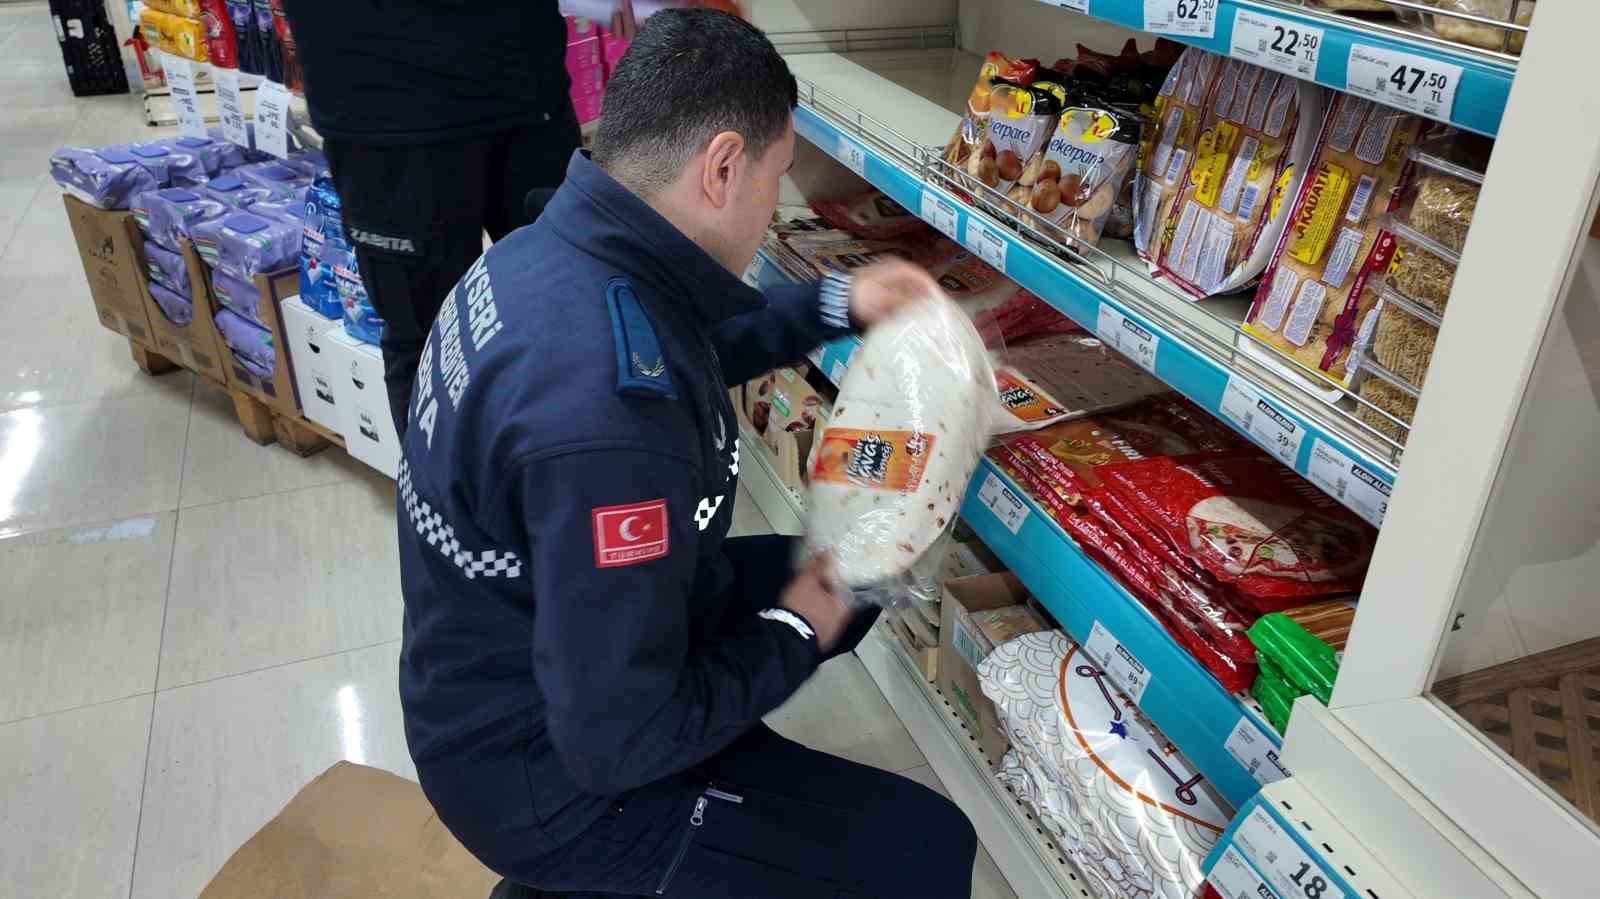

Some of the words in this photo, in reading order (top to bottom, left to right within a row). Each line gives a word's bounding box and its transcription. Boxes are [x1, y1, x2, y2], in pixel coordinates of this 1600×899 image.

[1303, 50, 1315, 61] TL
[1431, 90, 1443, 103] TL
[464, 255, 504, 352] YSERİ
